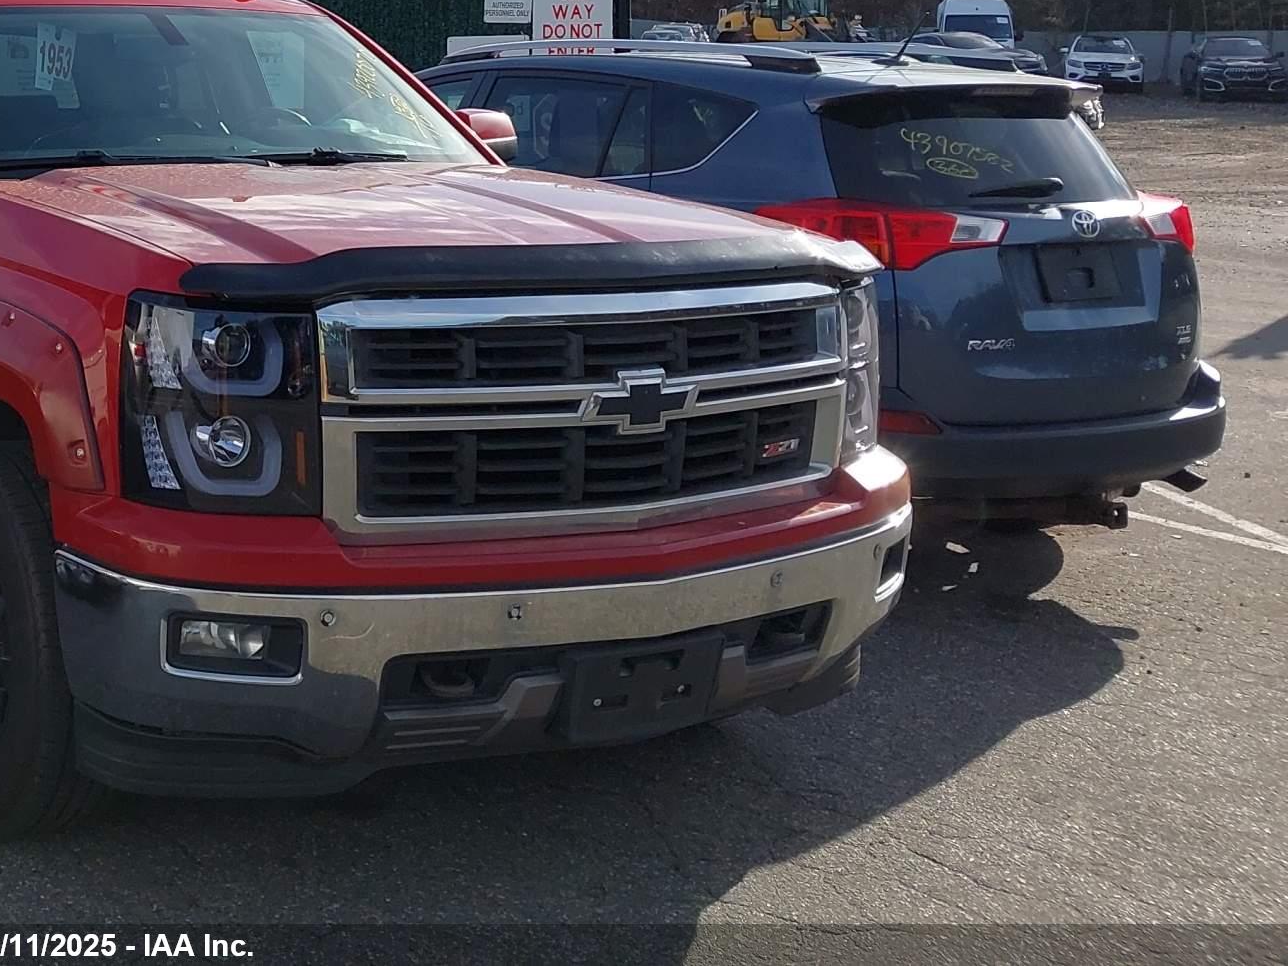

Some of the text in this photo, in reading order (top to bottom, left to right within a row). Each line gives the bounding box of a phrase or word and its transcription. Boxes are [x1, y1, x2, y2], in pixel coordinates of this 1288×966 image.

[552, 4, 594, 20] WAY
[542, 24, 603, 39] DO NOT
[39, 40, 72, 79] 1953
[967, 338, 1015, 351] RAV4
